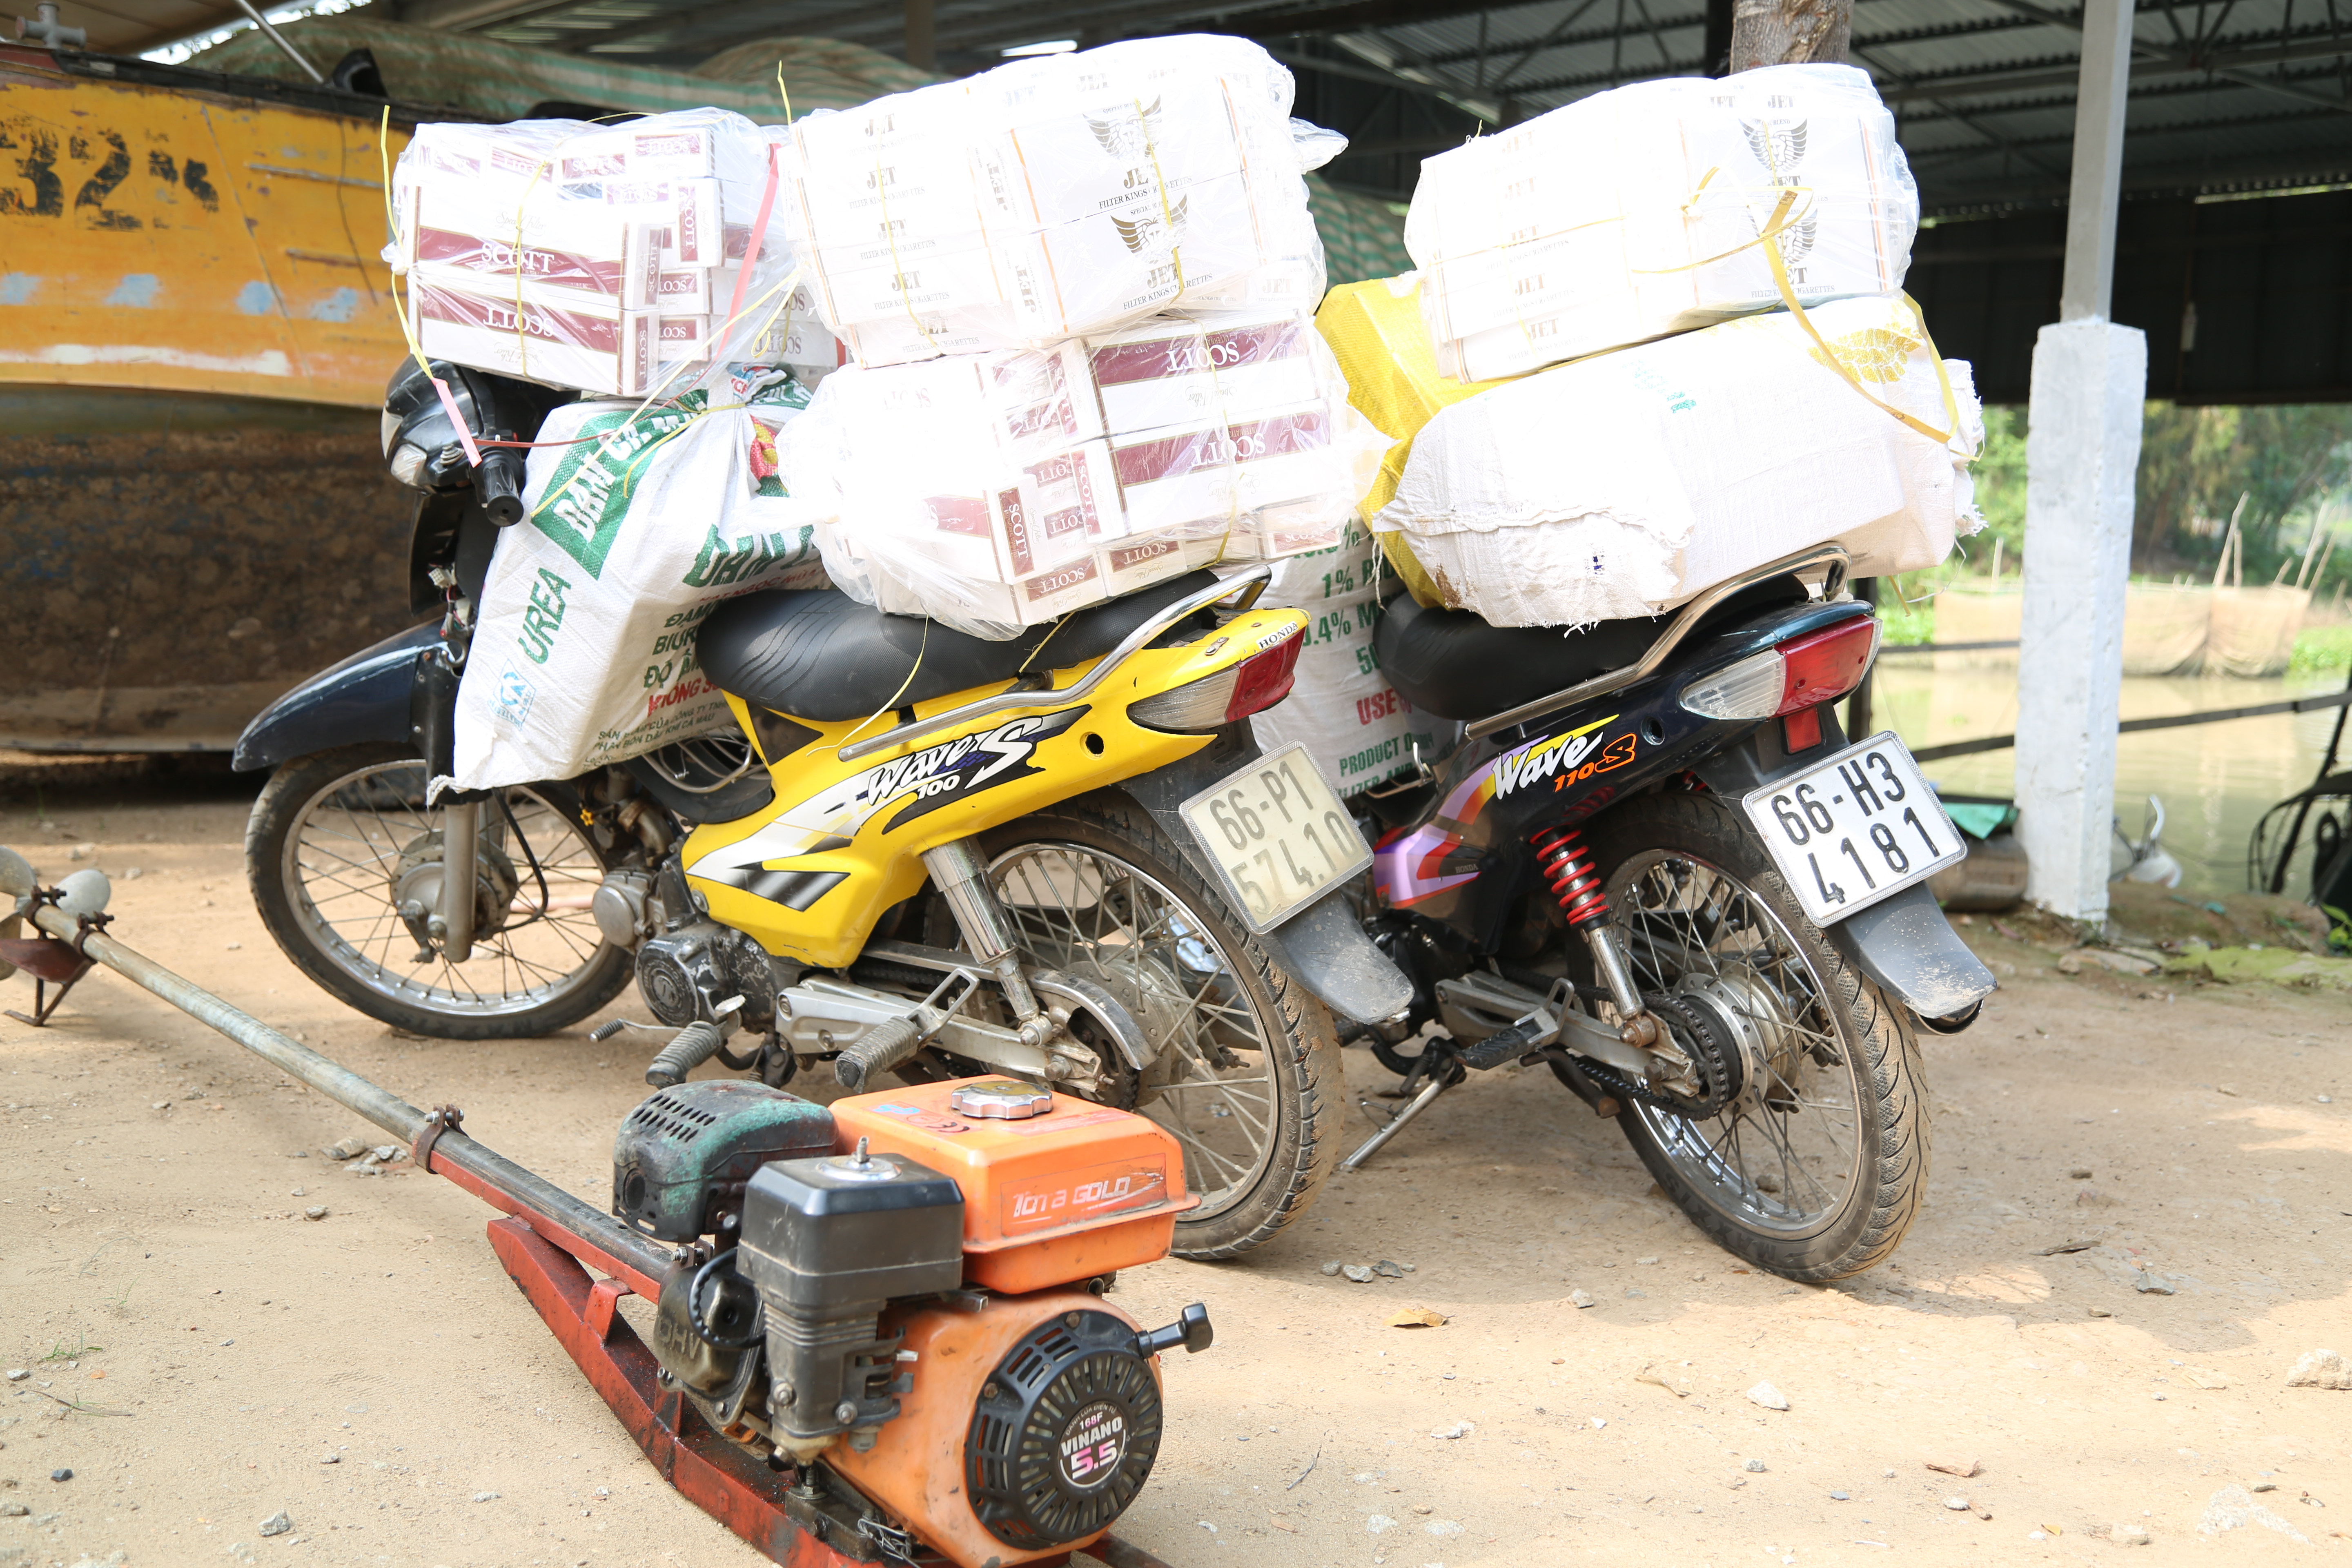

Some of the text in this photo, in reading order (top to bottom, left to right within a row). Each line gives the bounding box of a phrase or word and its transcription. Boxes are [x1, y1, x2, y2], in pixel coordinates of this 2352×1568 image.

[1076, 72, 1110, 93] JET
[1002, 85, 1036, 108] JET
[1767, 94, 1796, 109] JET
[1501, 129, 1536, 156] JET
[866, 165, 897, 189] JET
[986, 163, 1009, 212] JET
[1504, 176, 1537, 201] JET
[849, 198, 869, 209] FILTER
[1098, 195, 1124, 209] FILTER
[1125, 188, 1148, 202] KINGS
[684, 199, 695, 249] SCOTT
[878, 218, 909, 241] JET
[481, 242, 555, 273] SCOTT
[860, 250, 879, 260] FILTER
[899, 239, 936, 254] CIGARETTES
[1509, 252, 1528, 264] KINGS
[1529, 239, 1570, 257] CIGARETTES
[648, 243, 658, 292] SCOTT
[891, 270, 922, 292] JET
[1147, 262, 1180, 289] JET
[1773, 266, 1808, 286] ET
[1015, 265, 1037, 314] JET
[1262, 278, 1294, 294] JET
[1514, 272, 1546, 296] JET
[1792, 285, 1835, 295] CIGARETTES
[874, 301, 893, 310] FILTER
[914, 291, 950, 304] CIGARETTES
[1123, 296, 1147, 310] FILTER
[1148, 289, 1170, 303] KINGS
[483, 306, 554, 337] SCOTT
[917, 315, 949, 337] JET
[1527, 317, 1559, 341] JET
[902, 336, 980, 353] FILTER CIGARETTES
[1166, 341, 1240, 372] SCOTT
[1054, 367, 1074, 423] SCOTT
[1191, 432, 1266, 468] SCOTT
[1038, 461, 1074, 483] COTT
[1078, 465, 1096, 521] SCOTT
[1009, 503, 1029, 559] SCOTT
[1050, 513, 1084, 534] COTT
[1123, 541, 1167, 565] SCOTT
[1040, 567, 1085, 594] SCOTT
[1322, 566, 1354, 598] 1%
[518, 567, 572, 665] UREA
[652, 625, 695, 656] BIUR
[1259, 621, 1298, 649] HONDA
[1356, 688, 1397, 726] USE
[1339, 736, 1399, 777] PRODUCT
[1492, 731, 1604, 800] Wave
[917, 774, 961, 801] 100
[1771, 751, 1906, 846] 66-H3
[1208, 760, 1314, 851] 66-P1
[1229, 810, 1359, 915] 574.10
[1455, 863, 1479, 874] HONDA
[1807, 806, 1940, 905] 4181
[1072, 1176, 1131, 1205] GOLD
[658, 1318, 701, 1360] OHV
[1079, 1411, 1103, 1430] 168F
[1060, 1416, 1123, 1457] VINANO
[1070, 1438, 1118, 1481] 5.5
